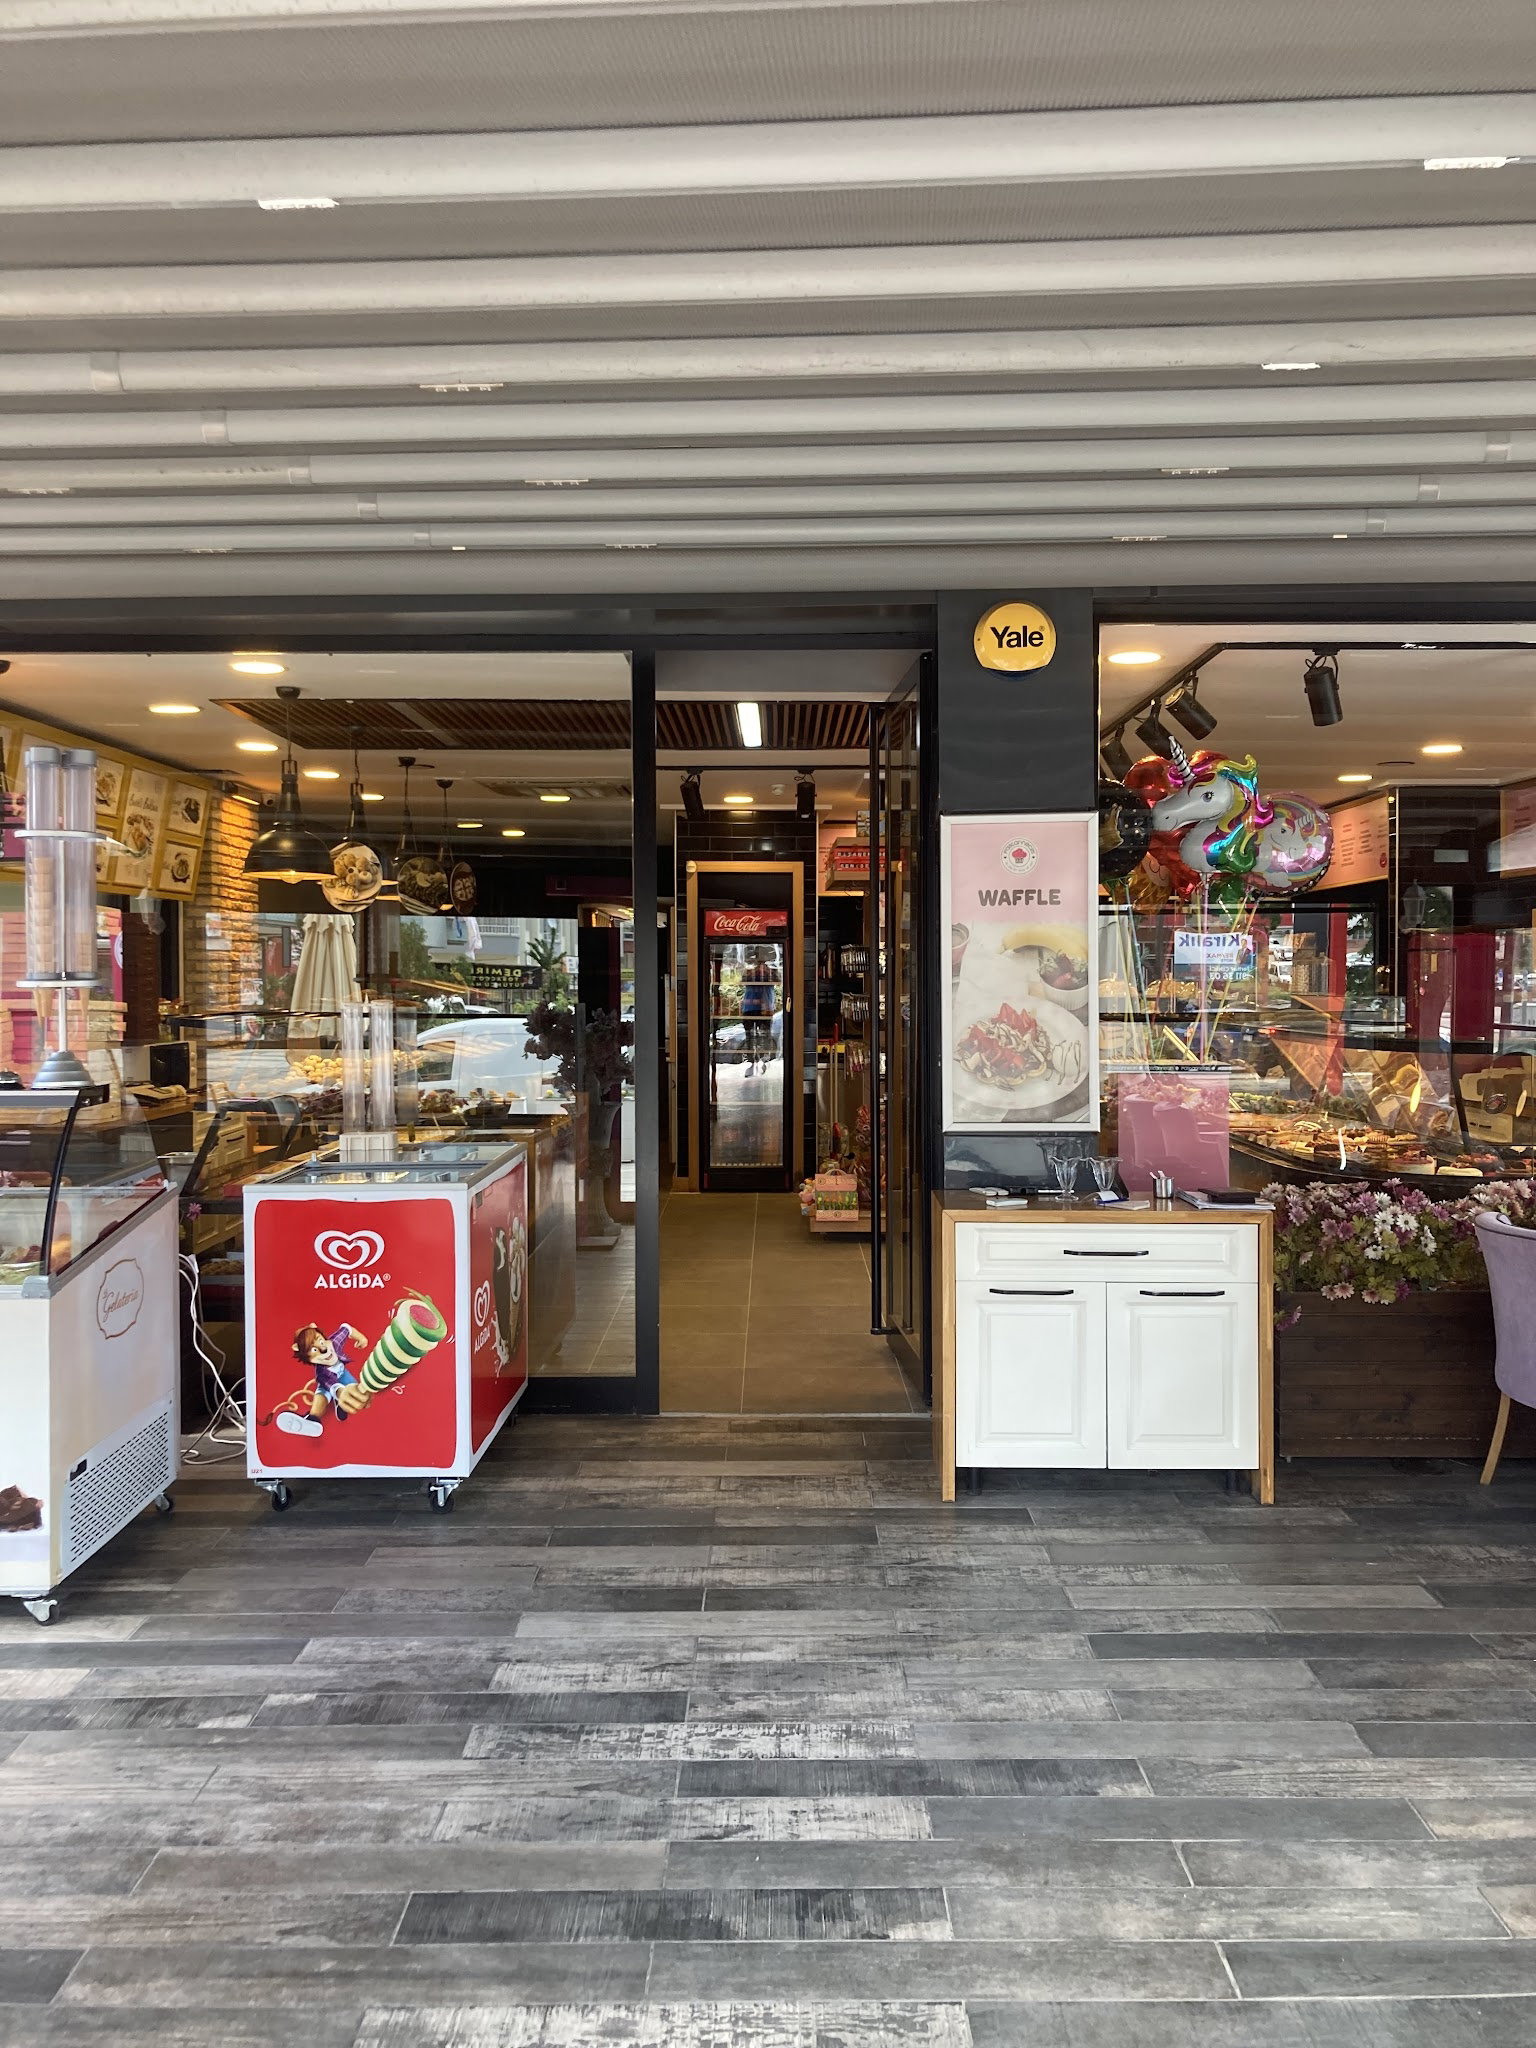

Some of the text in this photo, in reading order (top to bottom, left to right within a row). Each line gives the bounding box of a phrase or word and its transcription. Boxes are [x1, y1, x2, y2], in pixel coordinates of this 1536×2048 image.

[990, 625, 1044, 649] Yale
[978, 889, 1061, 907] WAFFLE
[103, 1289, 139, 1323] Gelateria
